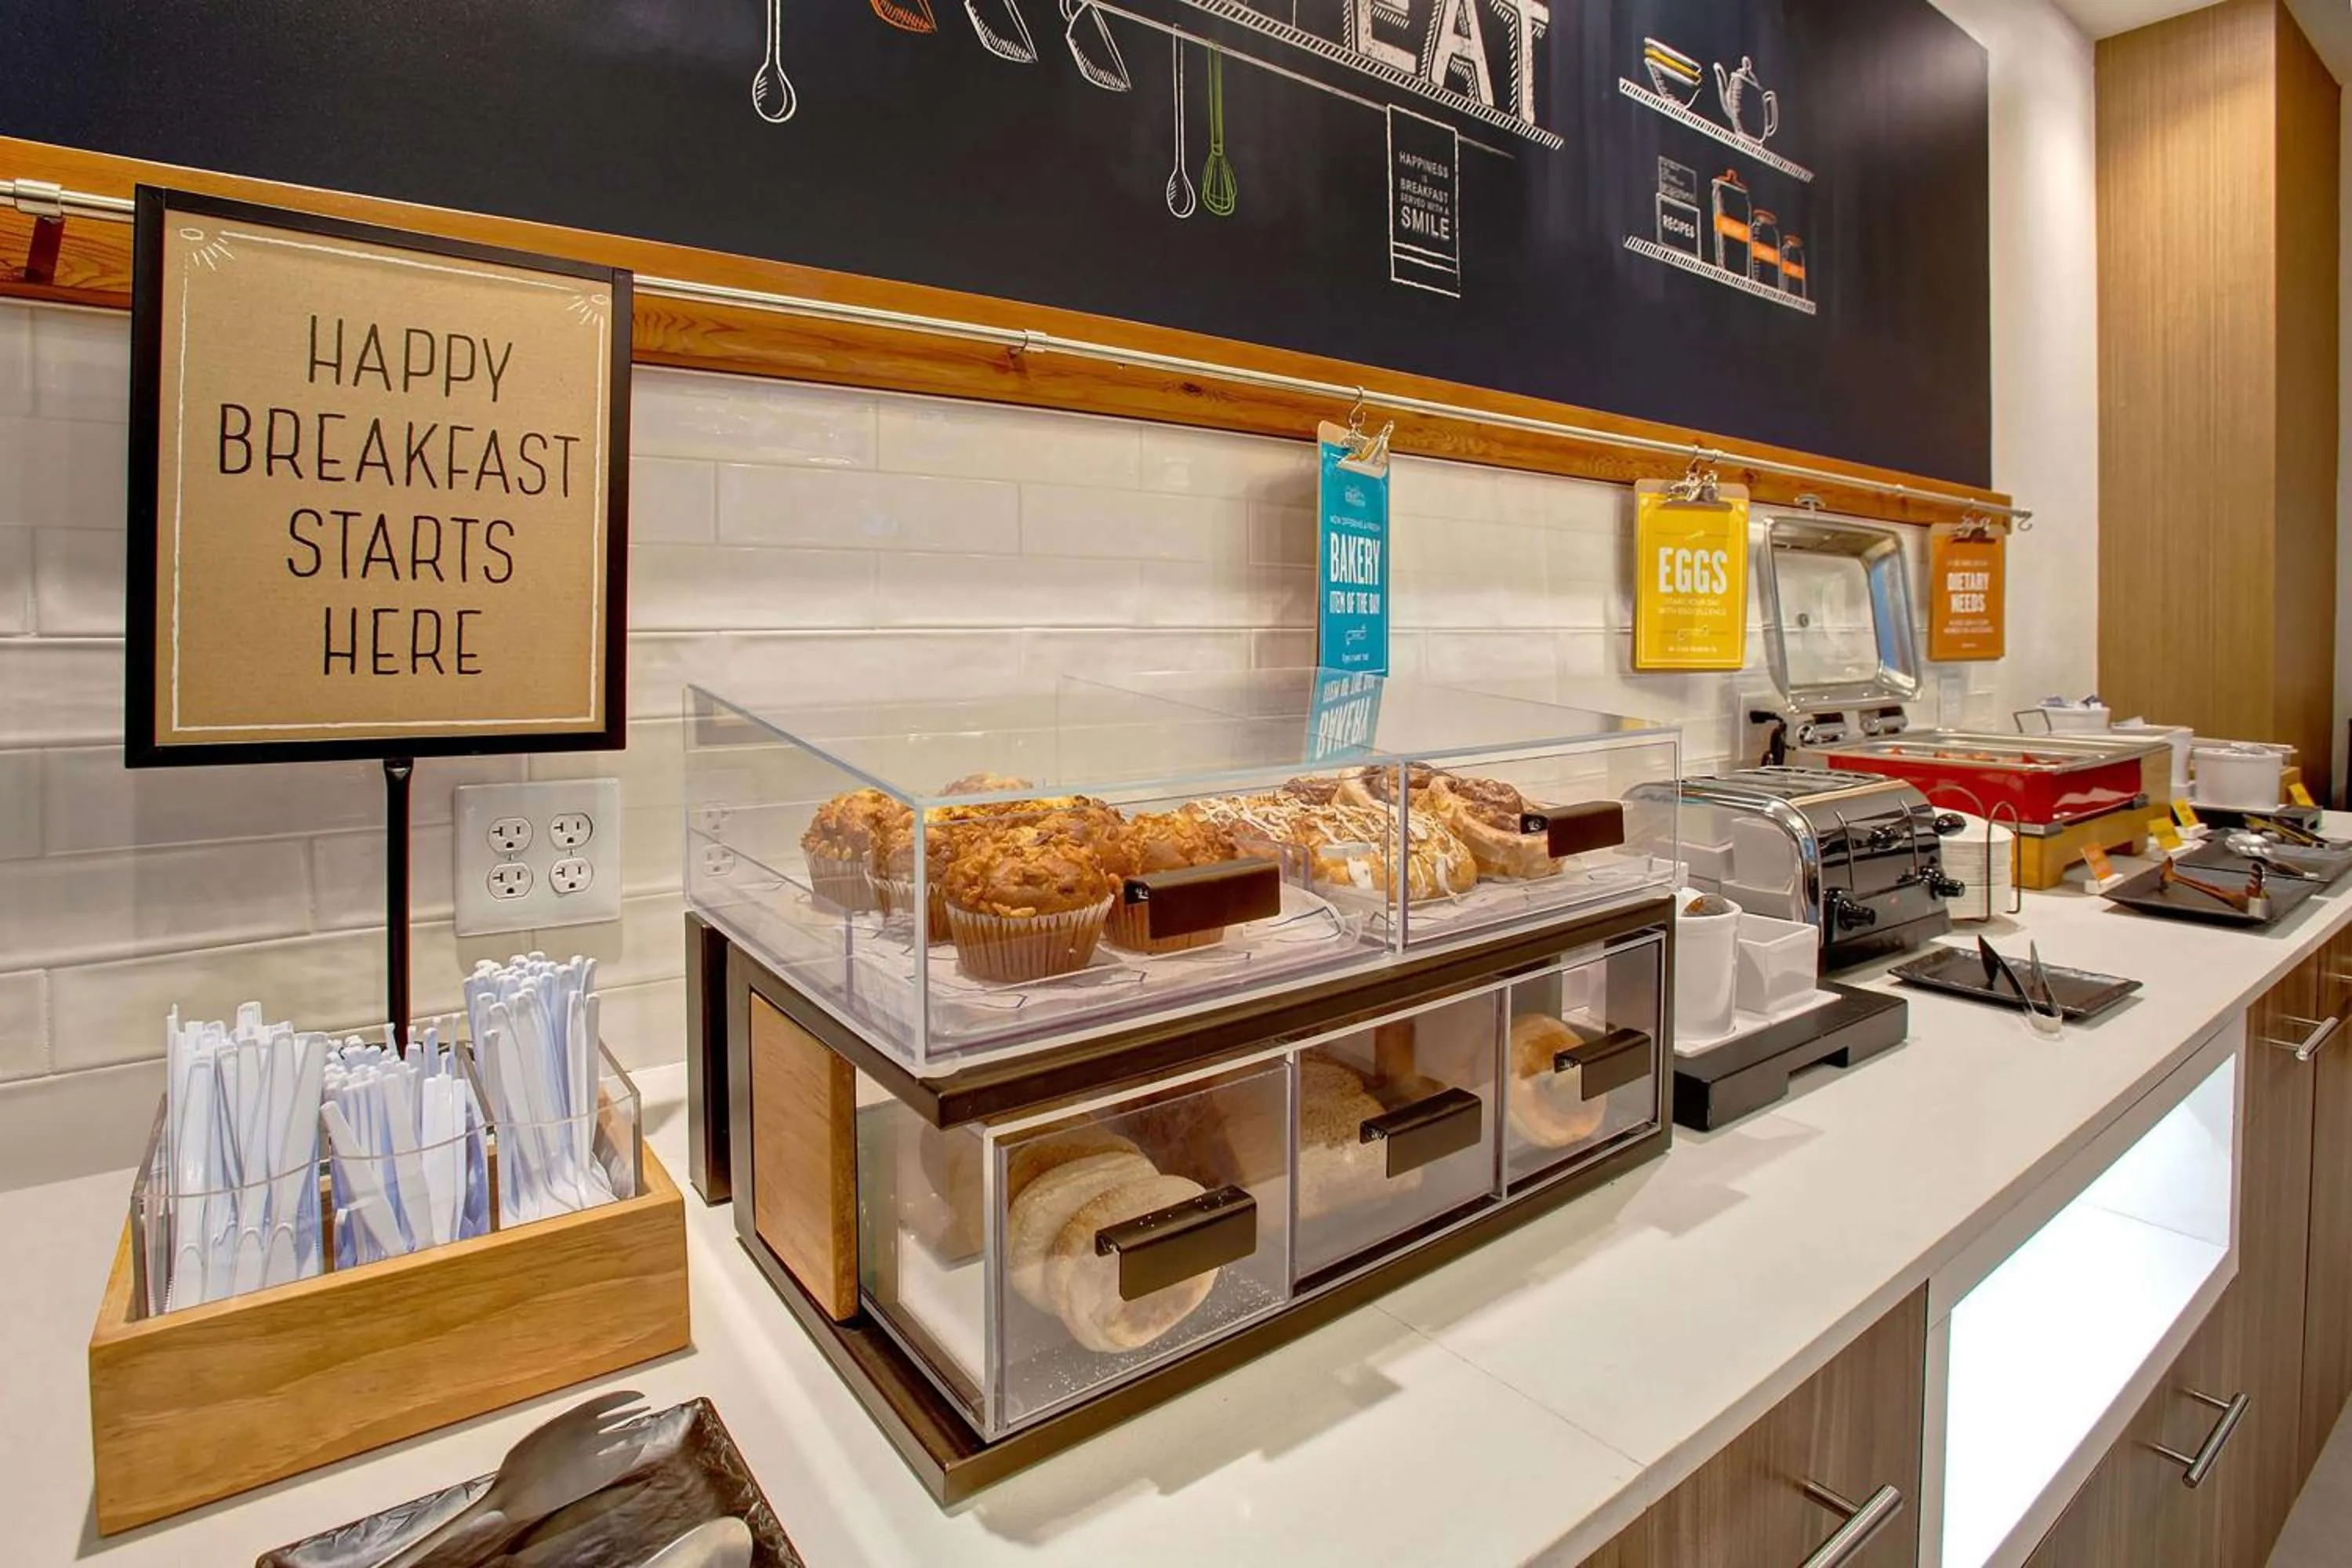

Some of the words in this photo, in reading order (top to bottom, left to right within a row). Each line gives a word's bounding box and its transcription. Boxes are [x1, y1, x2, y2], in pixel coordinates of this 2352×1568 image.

[1344, 0, 1550, 125] EAT
[1399, 150, 1449, 179] HAPPINESS
[1399, 177, 1449, 205] BREAKFAST
[1399, 192, 1425, 209] SERVED
[1444, 206, 1450, 216] A
[1400, 205, 1450, 240] SMILE
[1662, 214, 1695, 238] RECIPES
[308, 314, 514, 403] HAPPY
[218, 403, 581, 498] BREAKFAST
[286, 508, 516, 584] STARTS
[1330, 531, 1381, 586] BAKERY
[1658, 547, 1728, 594] EGGS
[1947, 572, 1989, 591] DIETARY
[1329, 590, 1345, 614] ITEM
[1346, 591, 1355, 614] OF
[1356, 592, 1368, 614] THE
[1951, 593, 1986, 613] NEEDS
[322, 606, 483, 676] HERE
